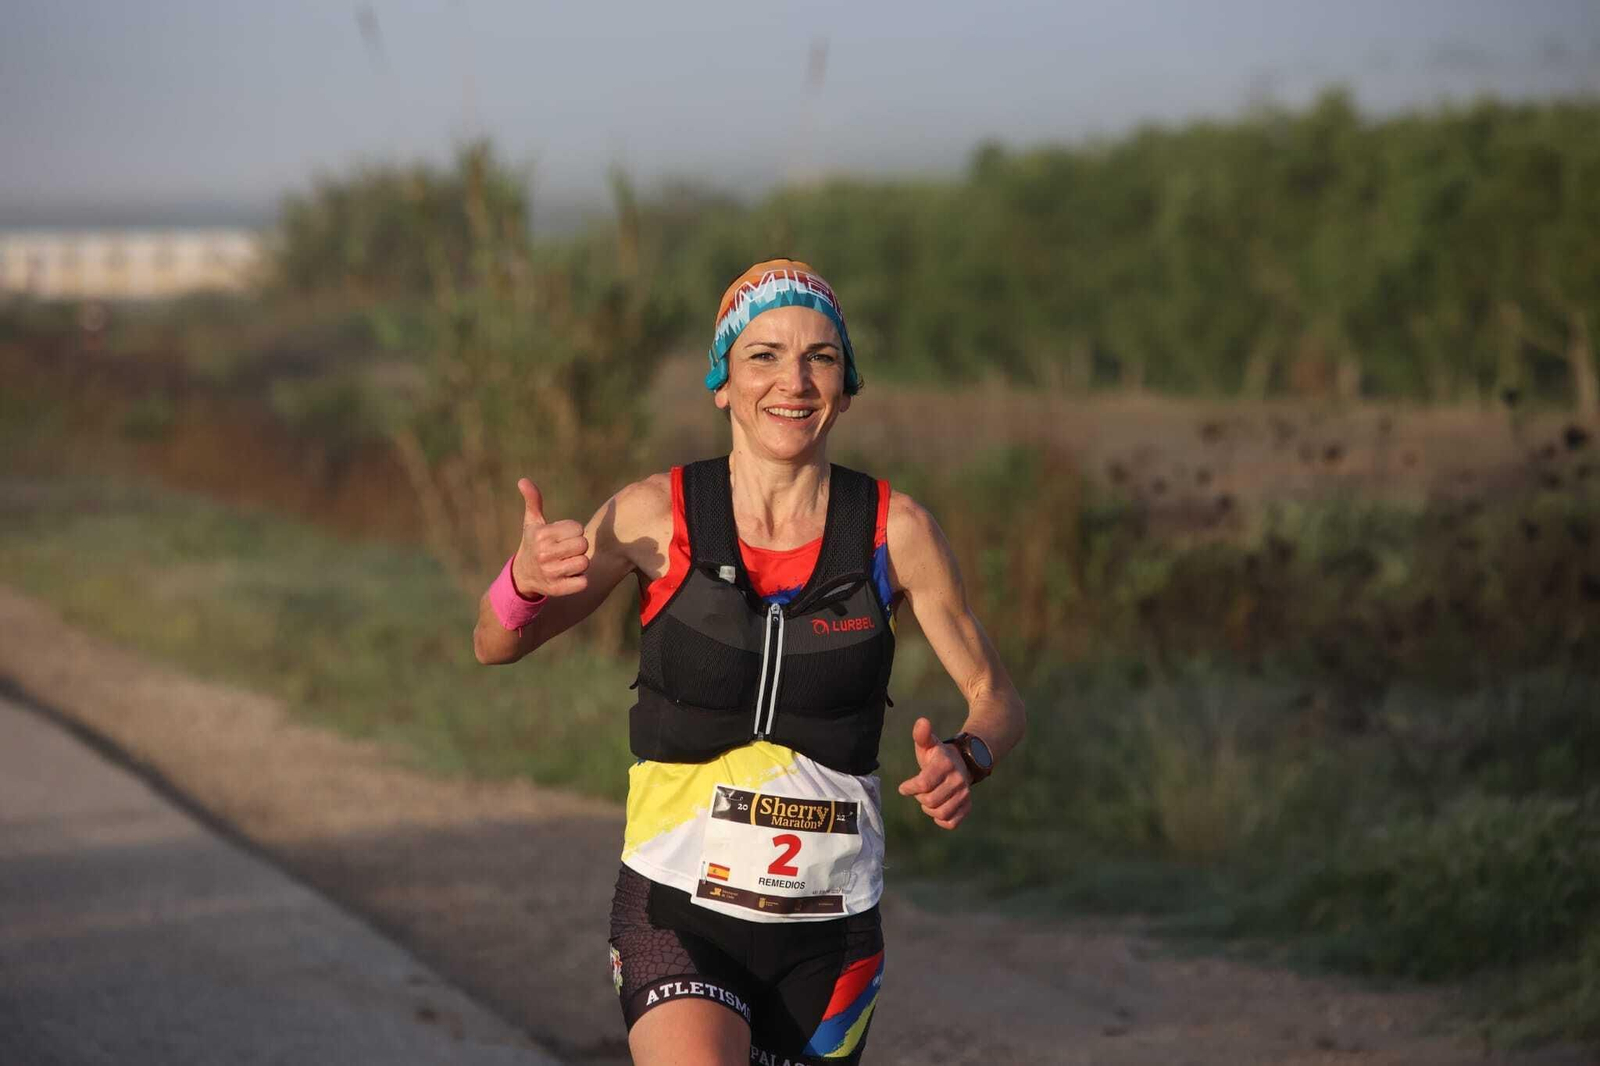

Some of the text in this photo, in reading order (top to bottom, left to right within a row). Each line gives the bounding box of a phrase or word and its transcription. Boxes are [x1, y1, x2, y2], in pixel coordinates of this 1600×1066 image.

[832, 617, 875, 632] LURBEL
[737, 803, 748, 811] 20
[759, 797, 830, 828] Sherry
[767, 833, 802, 877] 2
[758, 877, 806, 890] REMEDIOS
